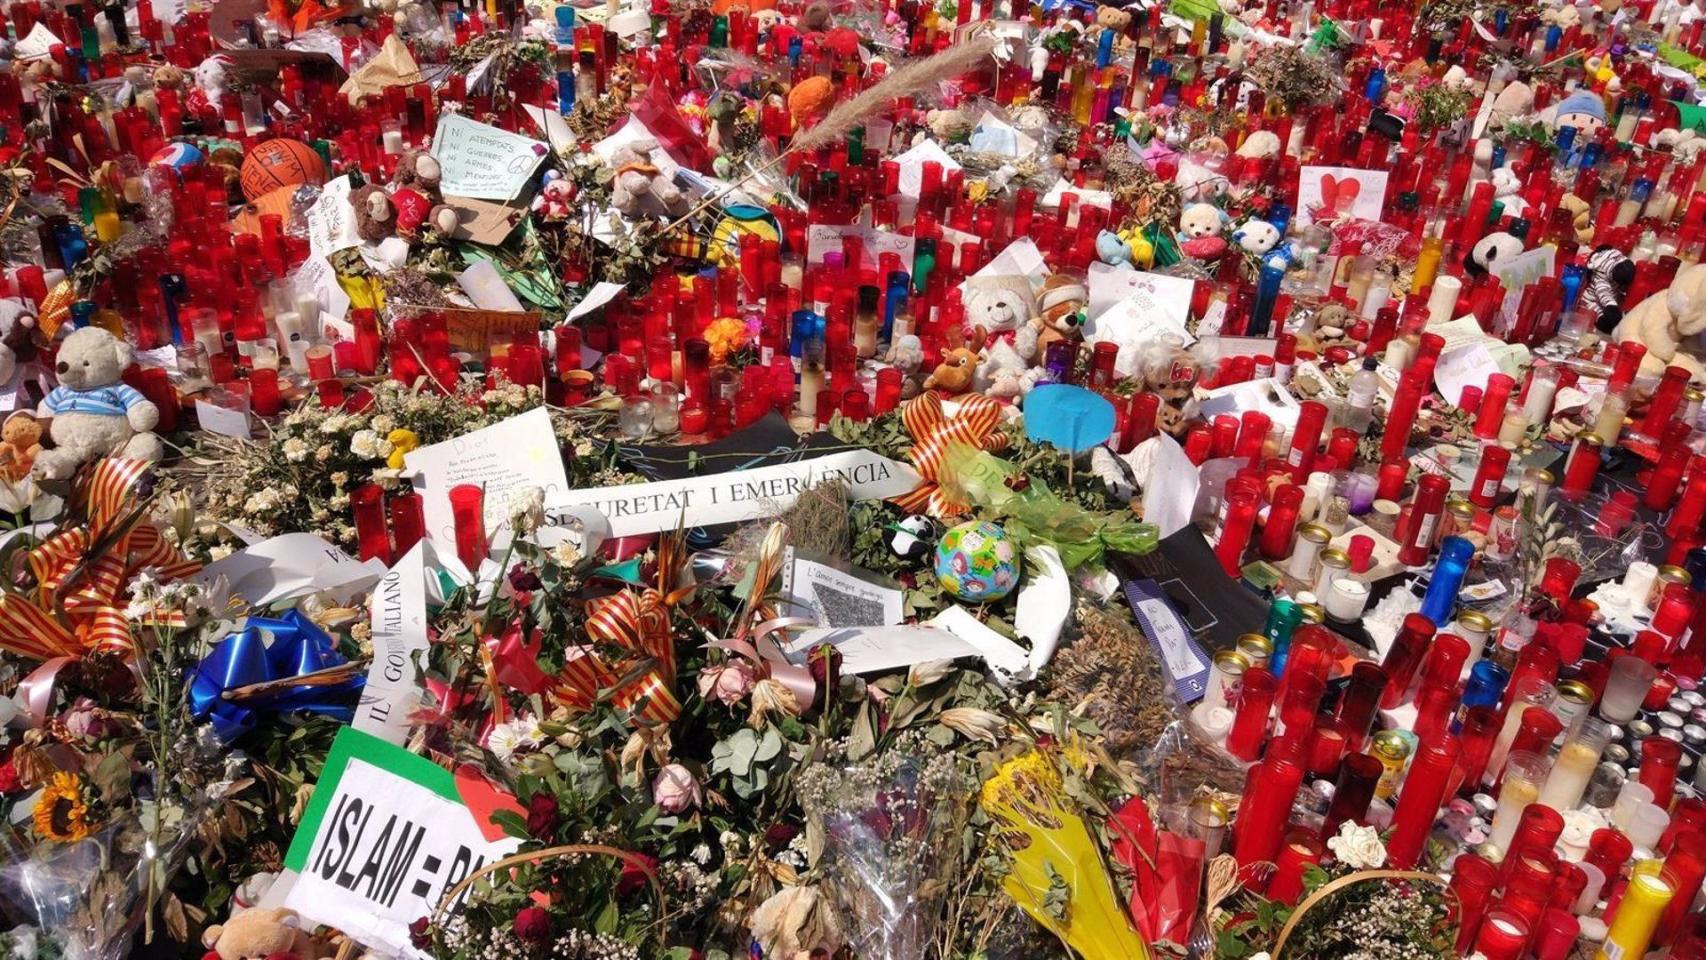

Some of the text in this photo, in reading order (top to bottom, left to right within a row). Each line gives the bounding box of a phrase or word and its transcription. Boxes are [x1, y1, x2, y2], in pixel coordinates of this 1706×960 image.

[711, 486, 718, 505] I
[369, 702, 392, 723] IL
[312, 793, 427, 909] ISLAM
